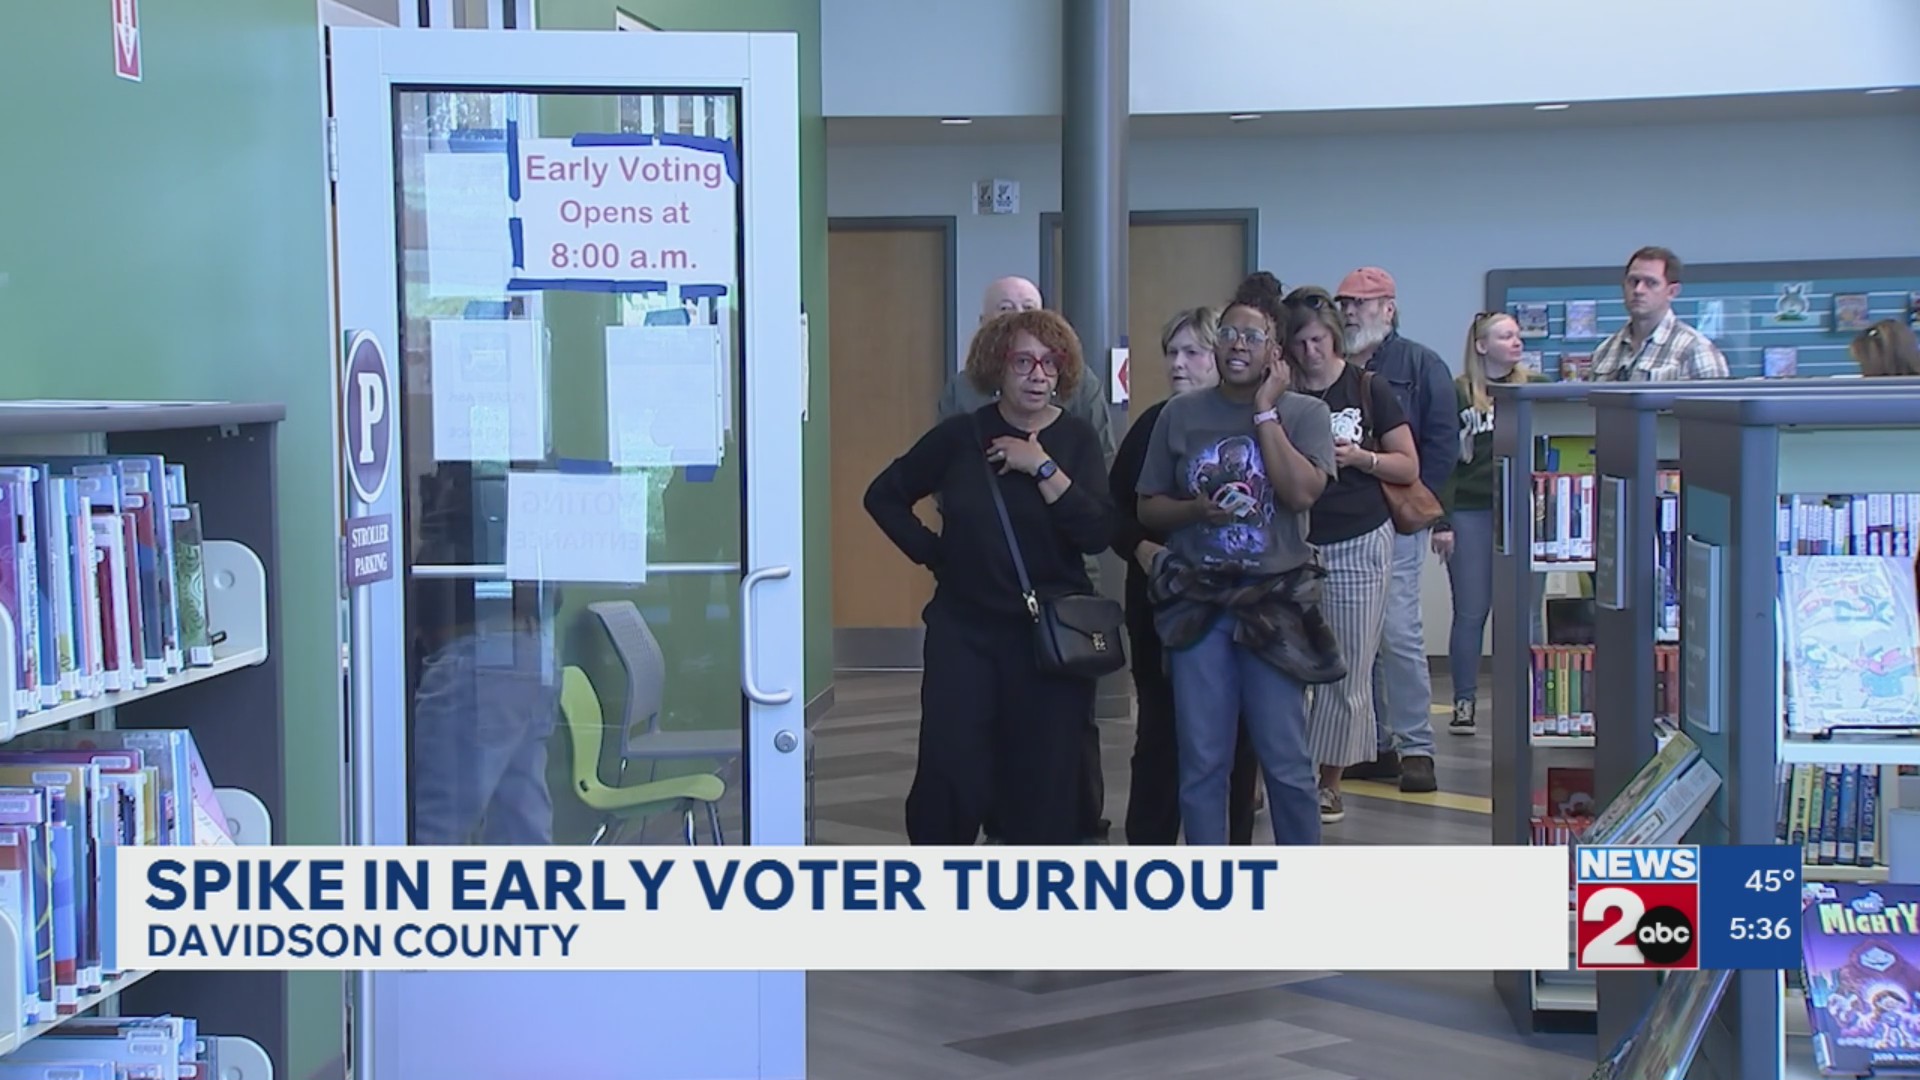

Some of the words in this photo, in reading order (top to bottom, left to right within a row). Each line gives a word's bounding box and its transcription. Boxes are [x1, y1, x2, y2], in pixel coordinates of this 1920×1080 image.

[526, 155, 608, 188] Early
[618, 156, 722, 189] Voting
[559, 200, 654, 229] Opens
[662, 201, 691, 224] at
[551, 242, 620, 269] 8:00
[630, 248, 698, 269] a.m.
[358, 372, 384, 465] P
[352, 523, 390, 548] STROLLER
[354, 552, 388, 577] PARKING
[1819, 902, 1919, 935] MIGHTY
